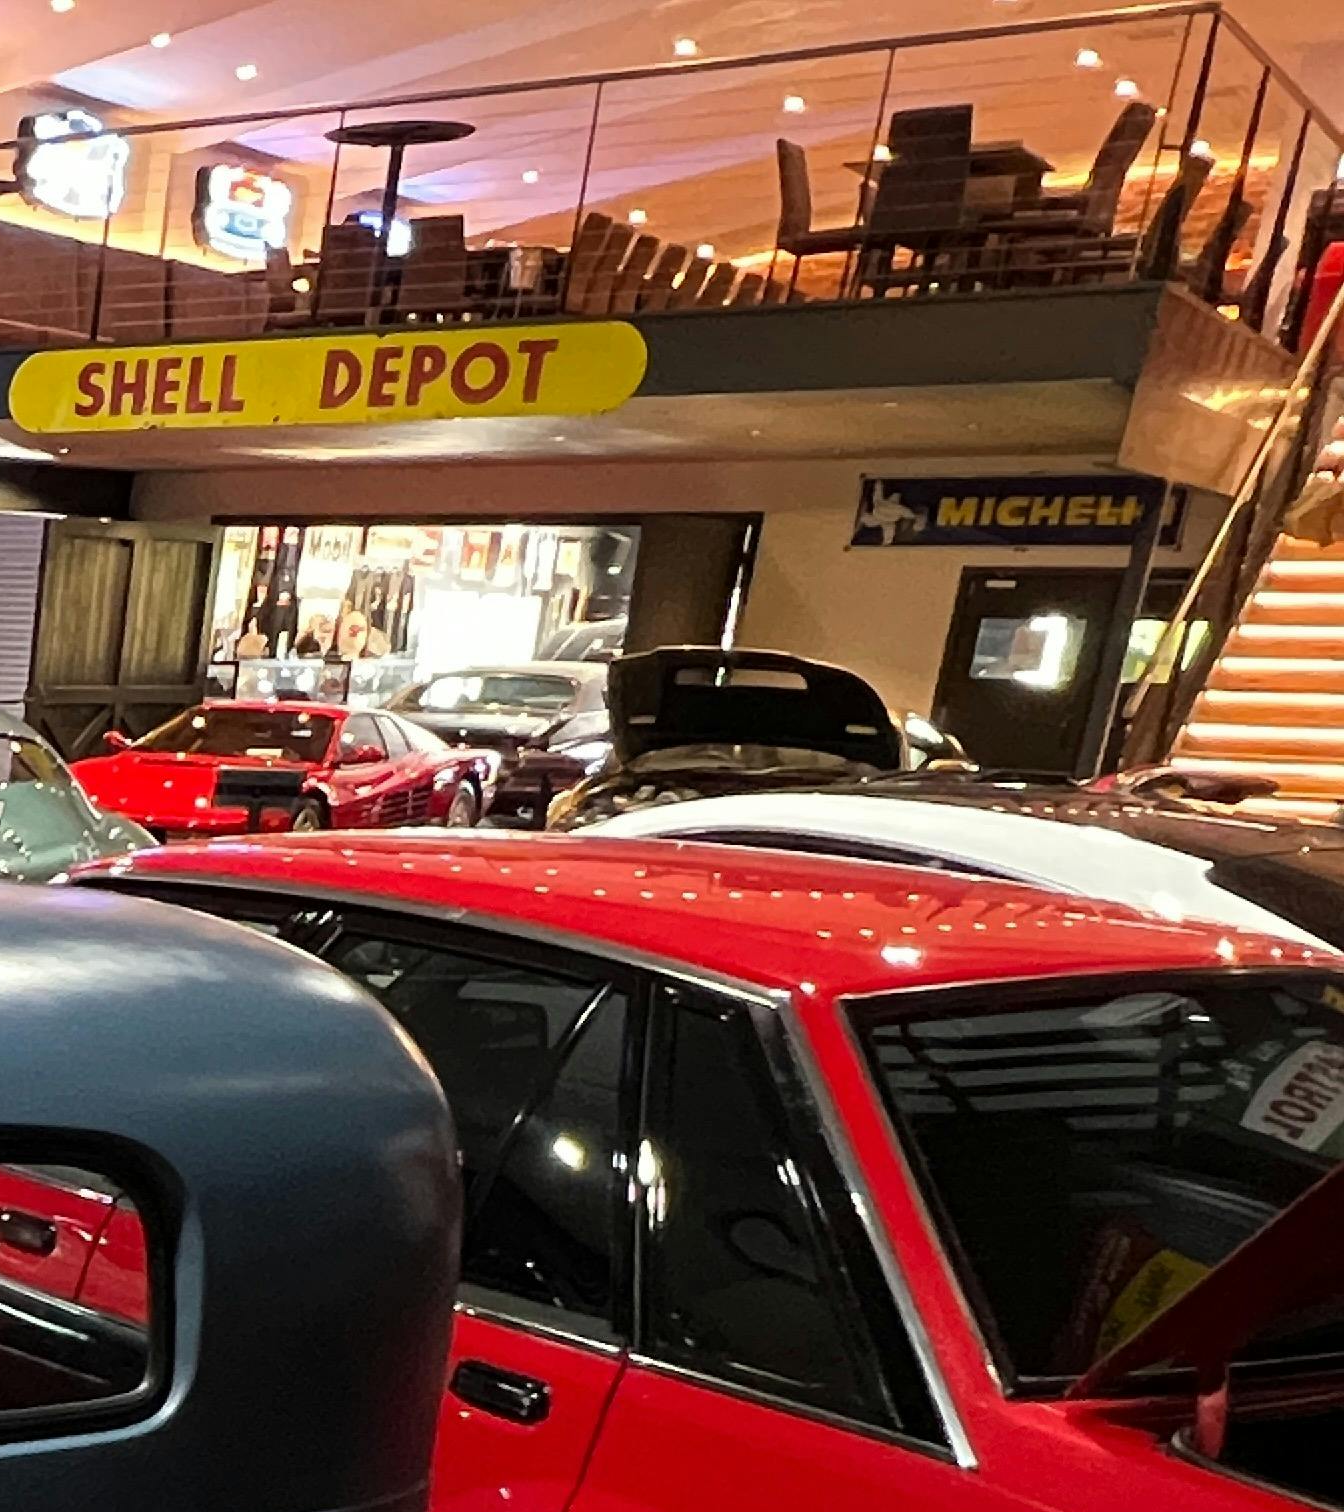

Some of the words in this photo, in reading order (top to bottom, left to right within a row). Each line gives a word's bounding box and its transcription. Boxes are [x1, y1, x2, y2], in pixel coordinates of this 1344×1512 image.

[74, 355, 245, 417] SHELL
[319, 339, 560, 410] DEPOT
[936, 495, 1175, 527] MICHELI
